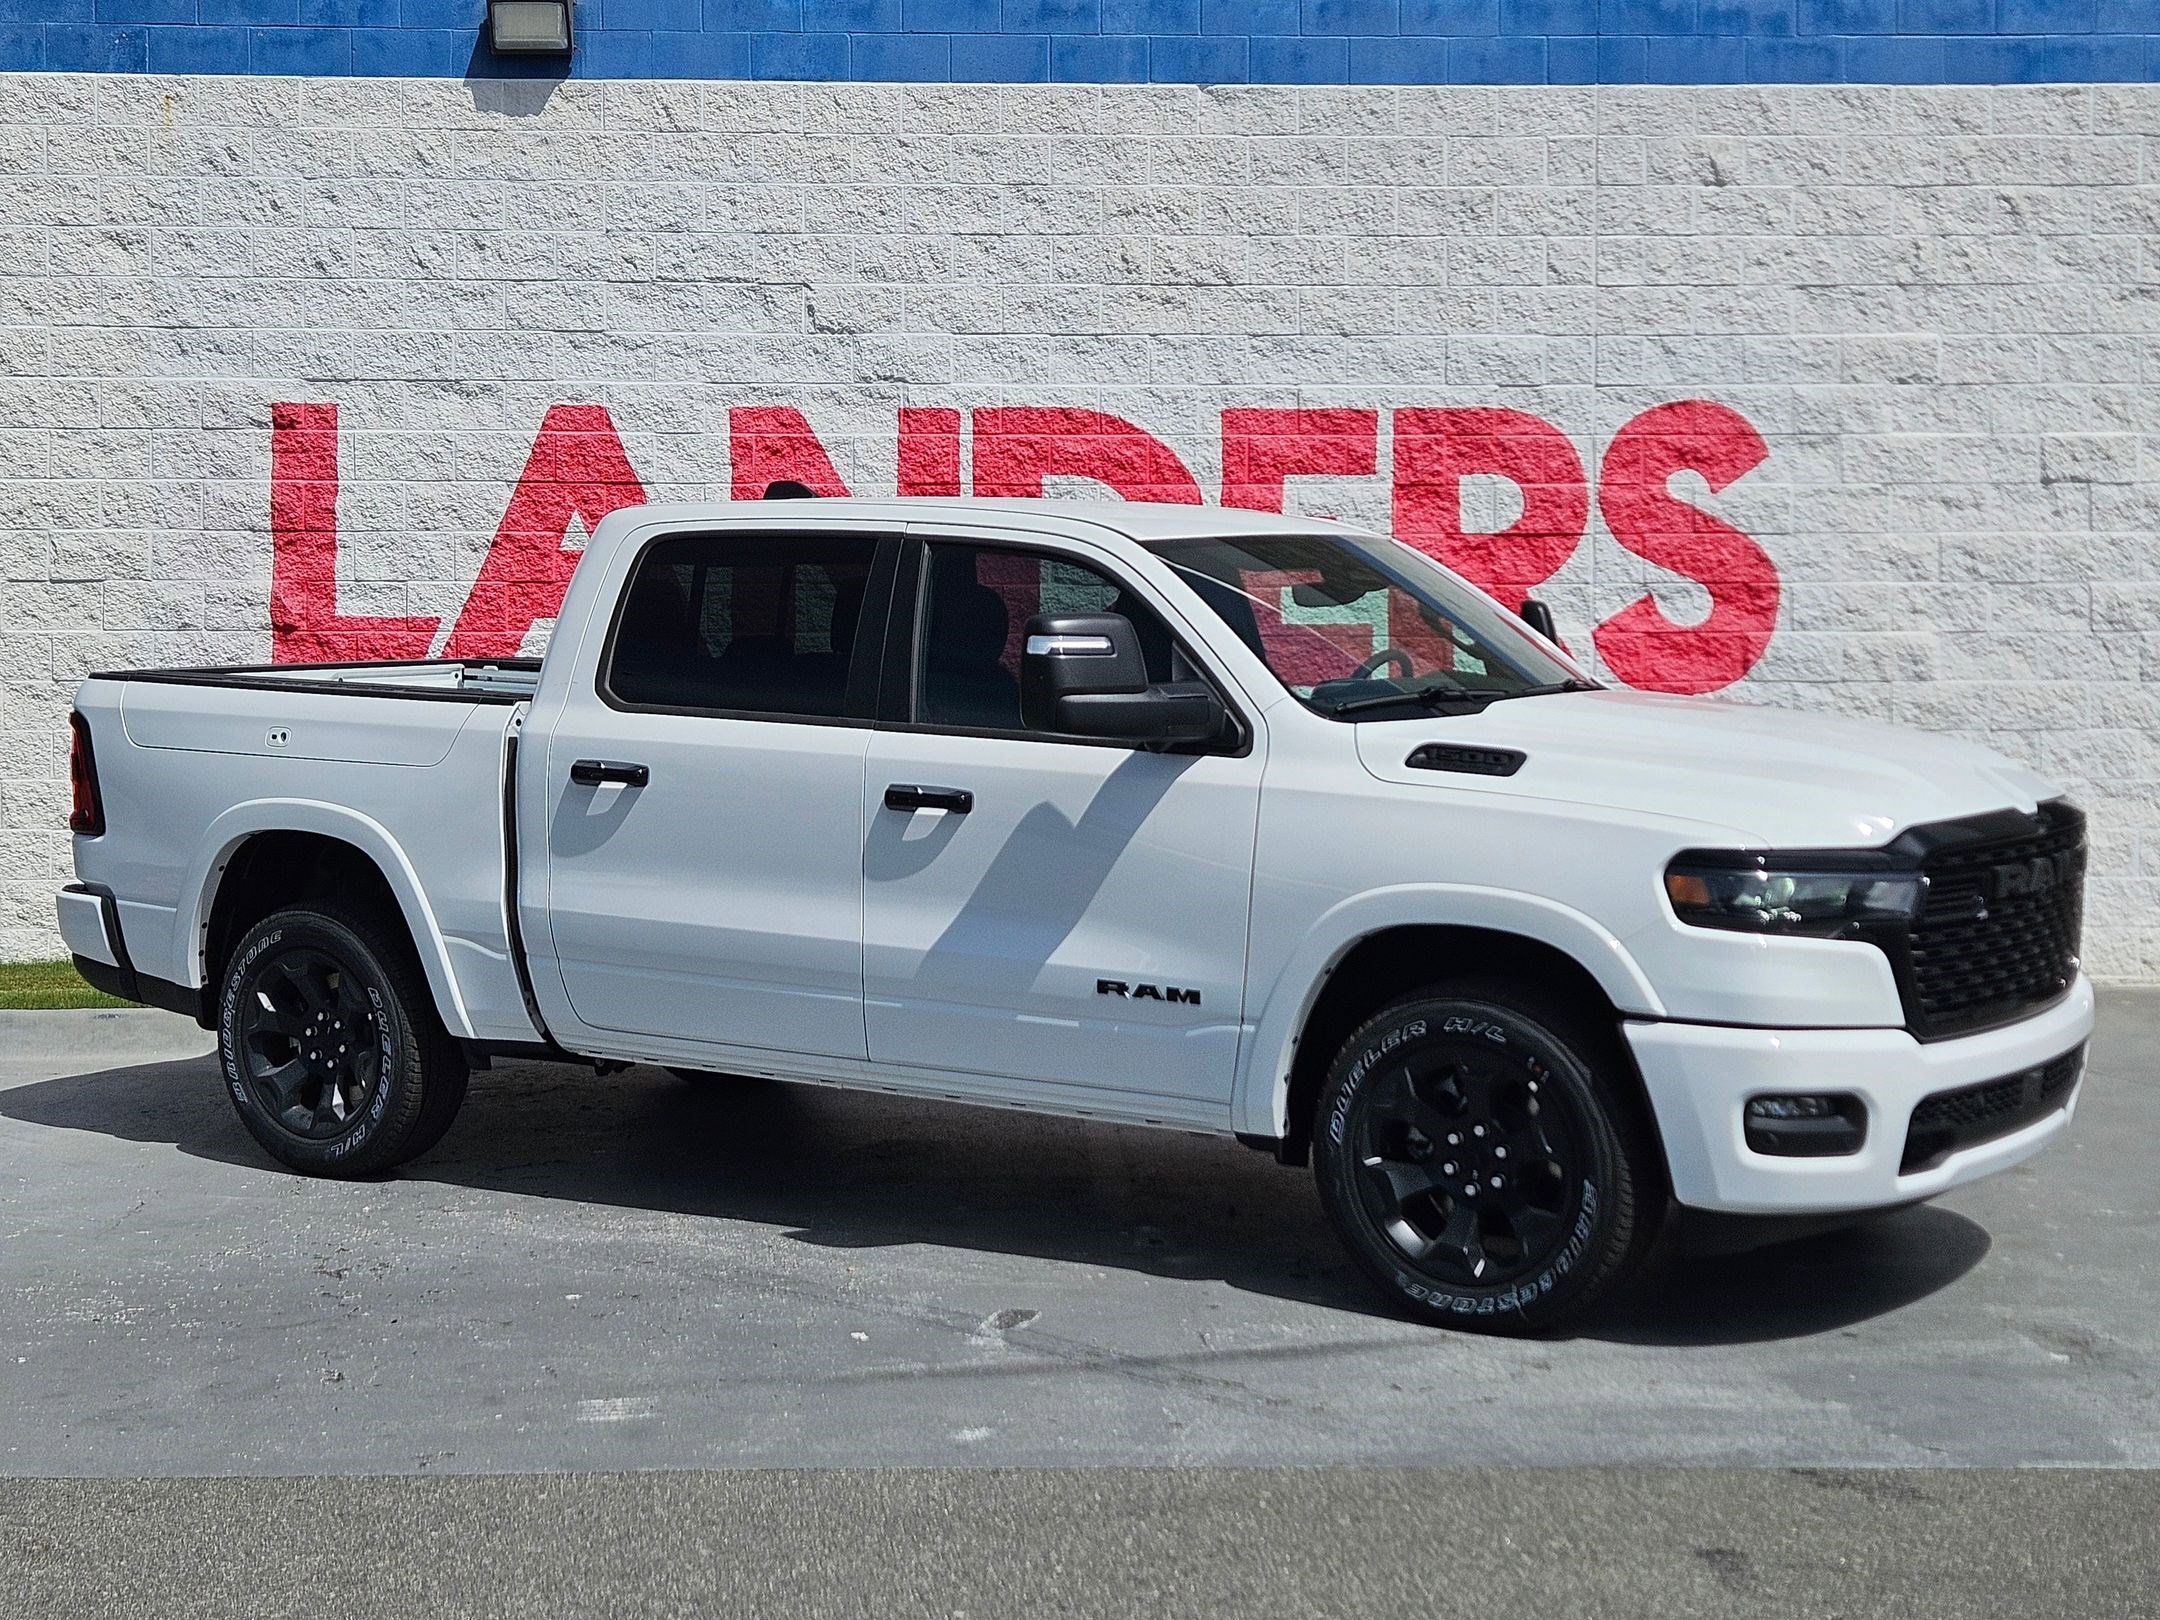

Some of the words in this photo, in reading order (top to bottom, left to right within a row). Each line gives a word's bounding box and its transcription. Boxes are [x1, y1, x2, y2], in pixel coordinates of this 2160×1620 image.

[221, 929, 282, 1104] BRIDGESTONE
[368, 987, 392, 1120] DUELER
[1097, 979, 1200, 1004] RAM
[330, 1124, 366, 1160] H/L
[1328, 1019, 1427, 1147] DUELER
[1443, 1016, 1507, 1044] H/L
